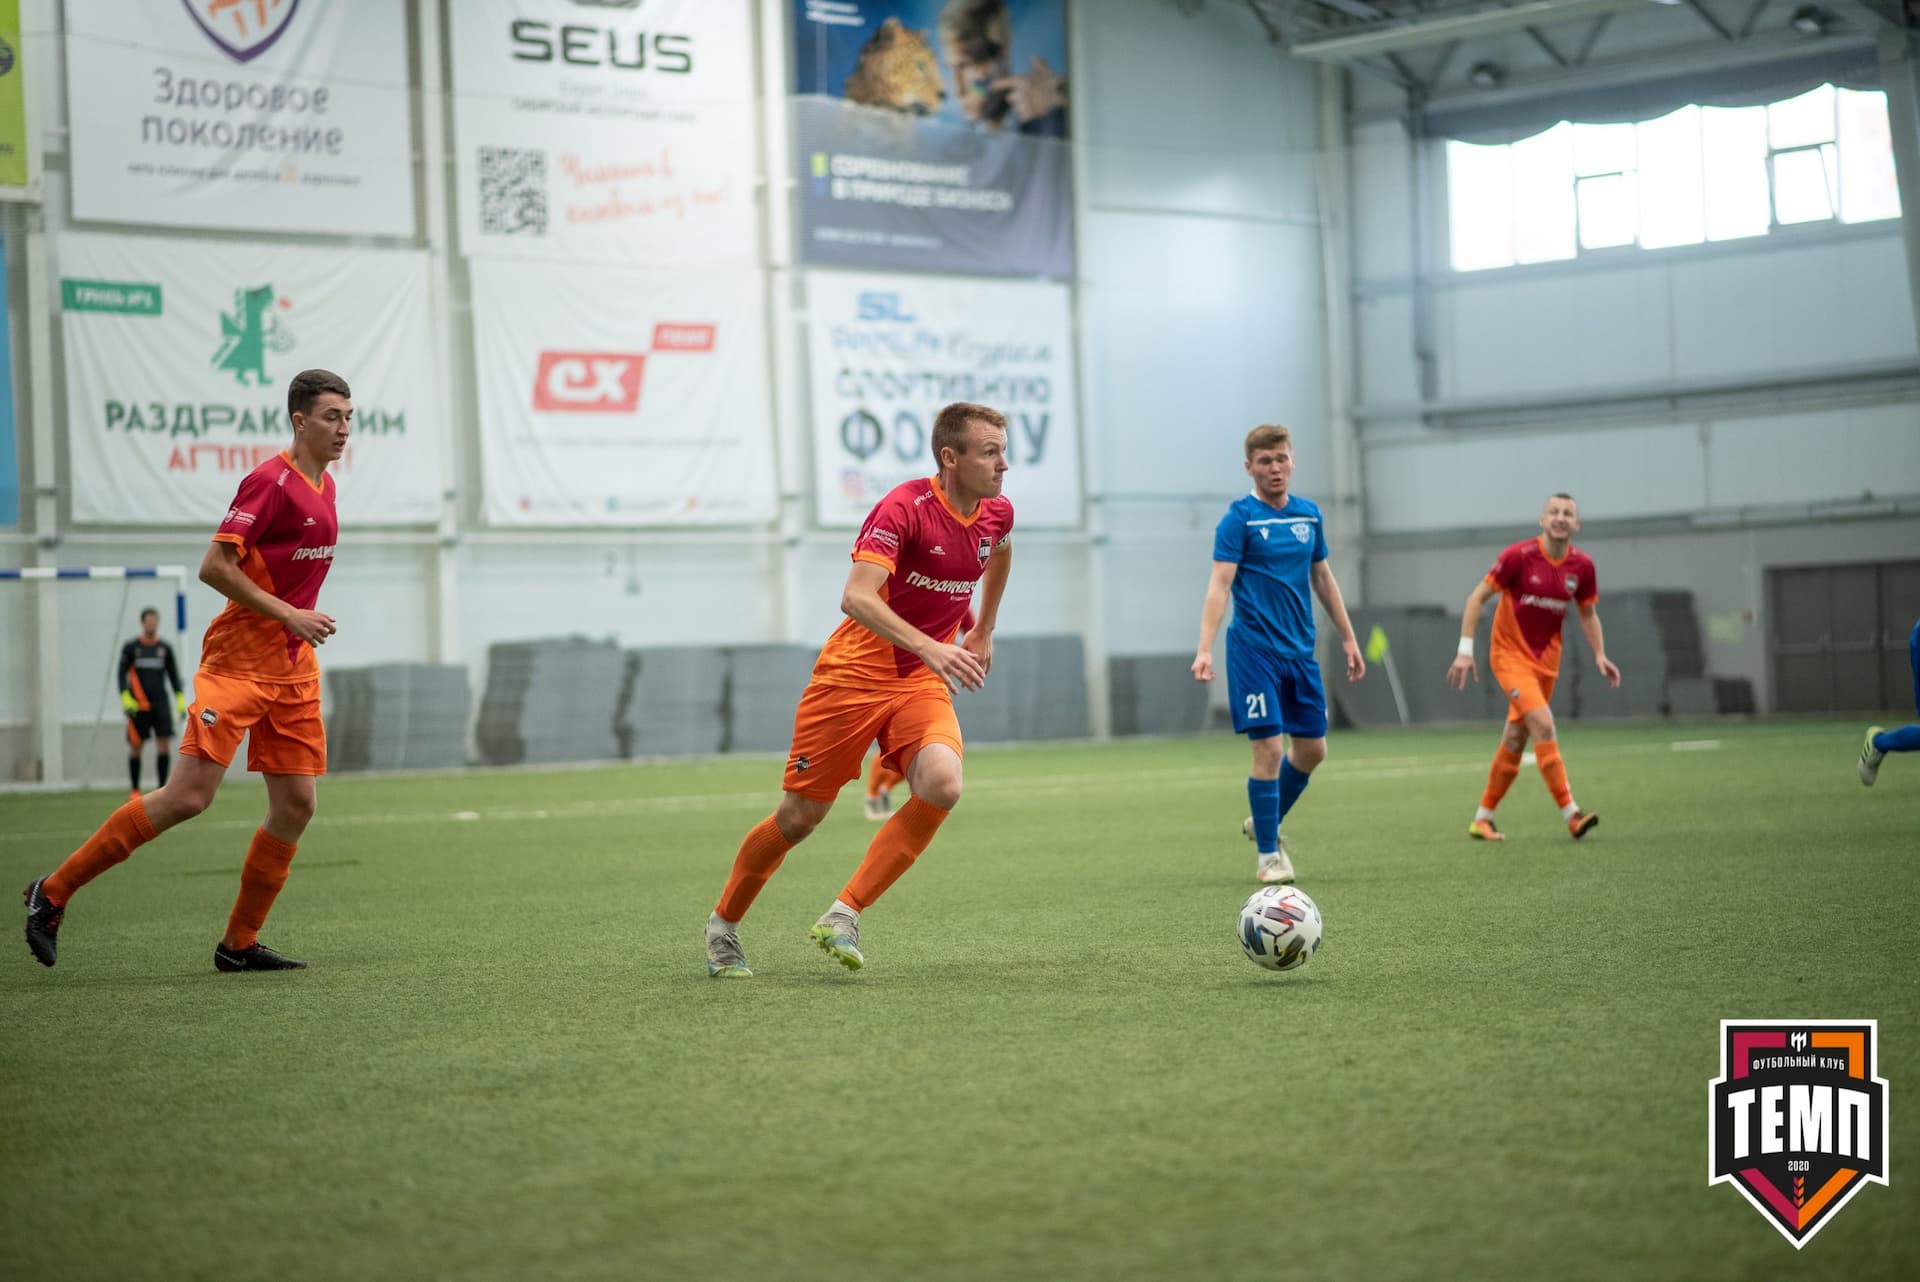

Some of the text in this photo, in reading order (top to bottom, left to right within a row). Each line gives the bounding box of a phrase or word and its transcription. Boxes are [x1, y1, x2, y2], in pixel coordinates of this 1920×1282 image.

[512, 20, 692, 73] SEUS
[153, 67, 330, 114] Здоровое
[141, 115, 344, 155] поколение
[105, 401, 406, 437] РАЗДРАКИМ
[840, 407, 1052, 466] ФОУ
[1246, 692, 1267, 718] 21
